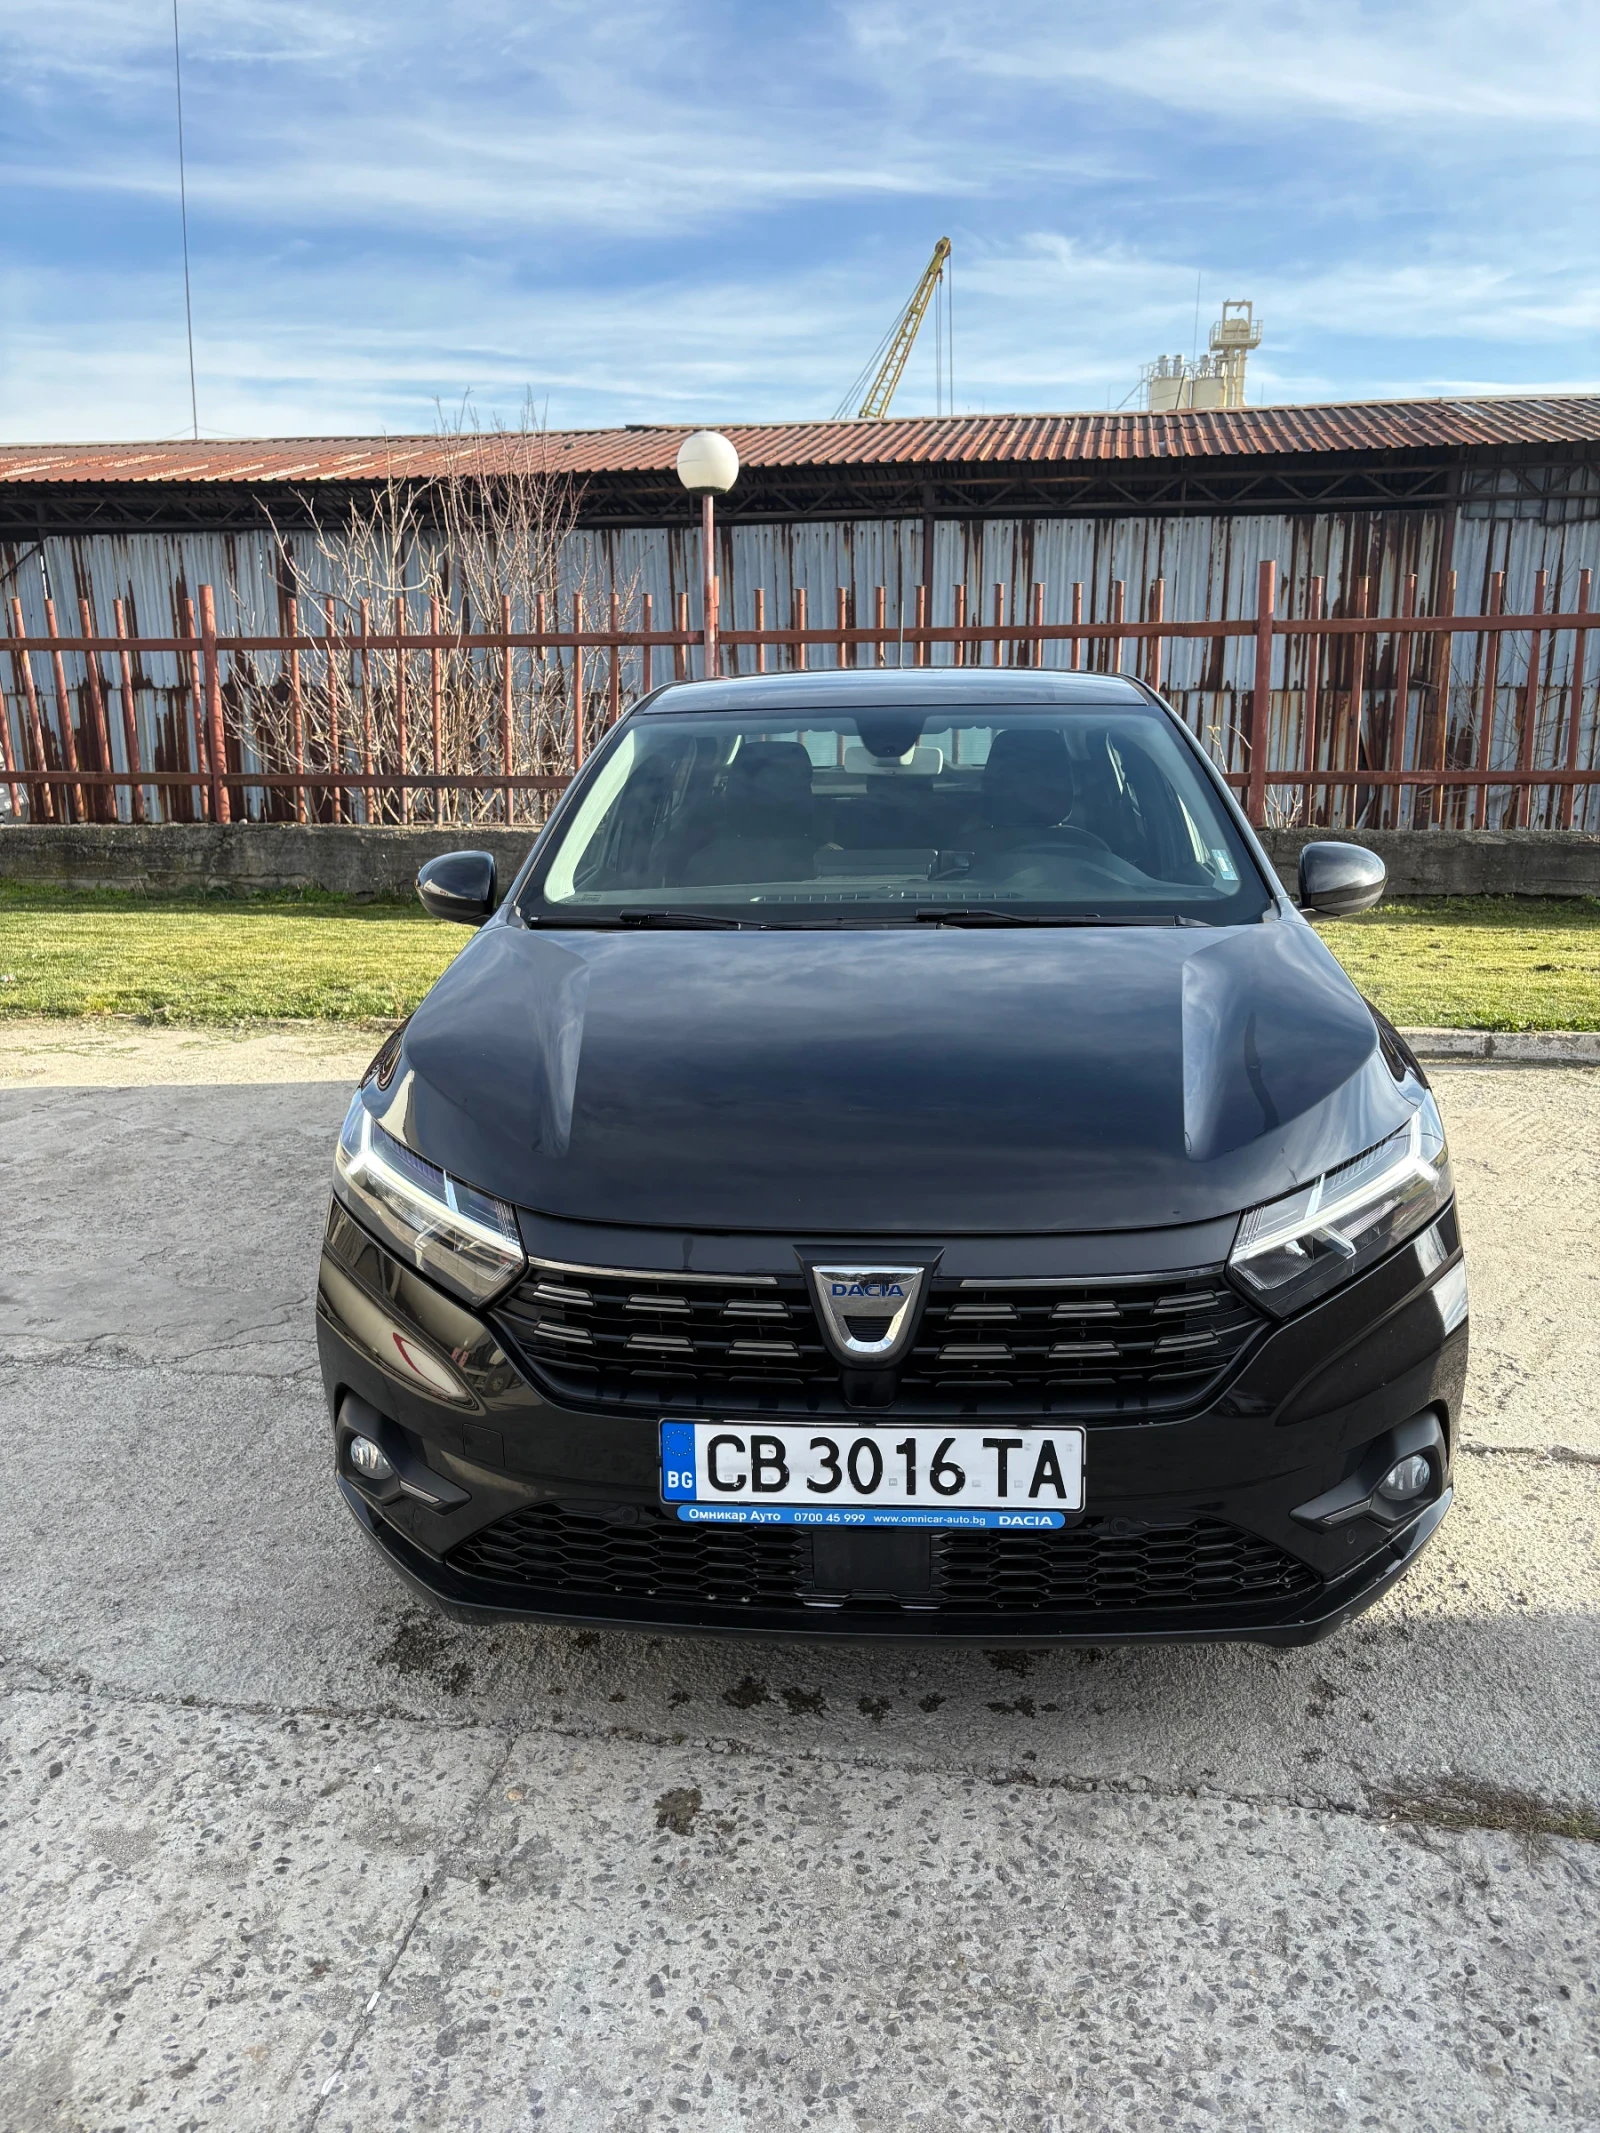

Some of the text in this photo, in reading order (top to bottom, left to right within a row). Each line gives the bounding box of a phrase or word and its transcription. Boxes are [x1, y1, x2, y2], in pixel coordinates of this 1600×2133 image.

[832, 1284, 904, 1297] DACIA
[708, 1434, 1067, 1499] CB 3016 TA
[667, 1471, 693, 1489] BG
[689, 1508, 781, 1523] Омникар Ауто
[793, 1512, 866, 1523] 0700 45 999
[873, 1514, 986, 1526] www.omnicar-auto.bg
[999, 1516, 1053, 1526] DACIA
